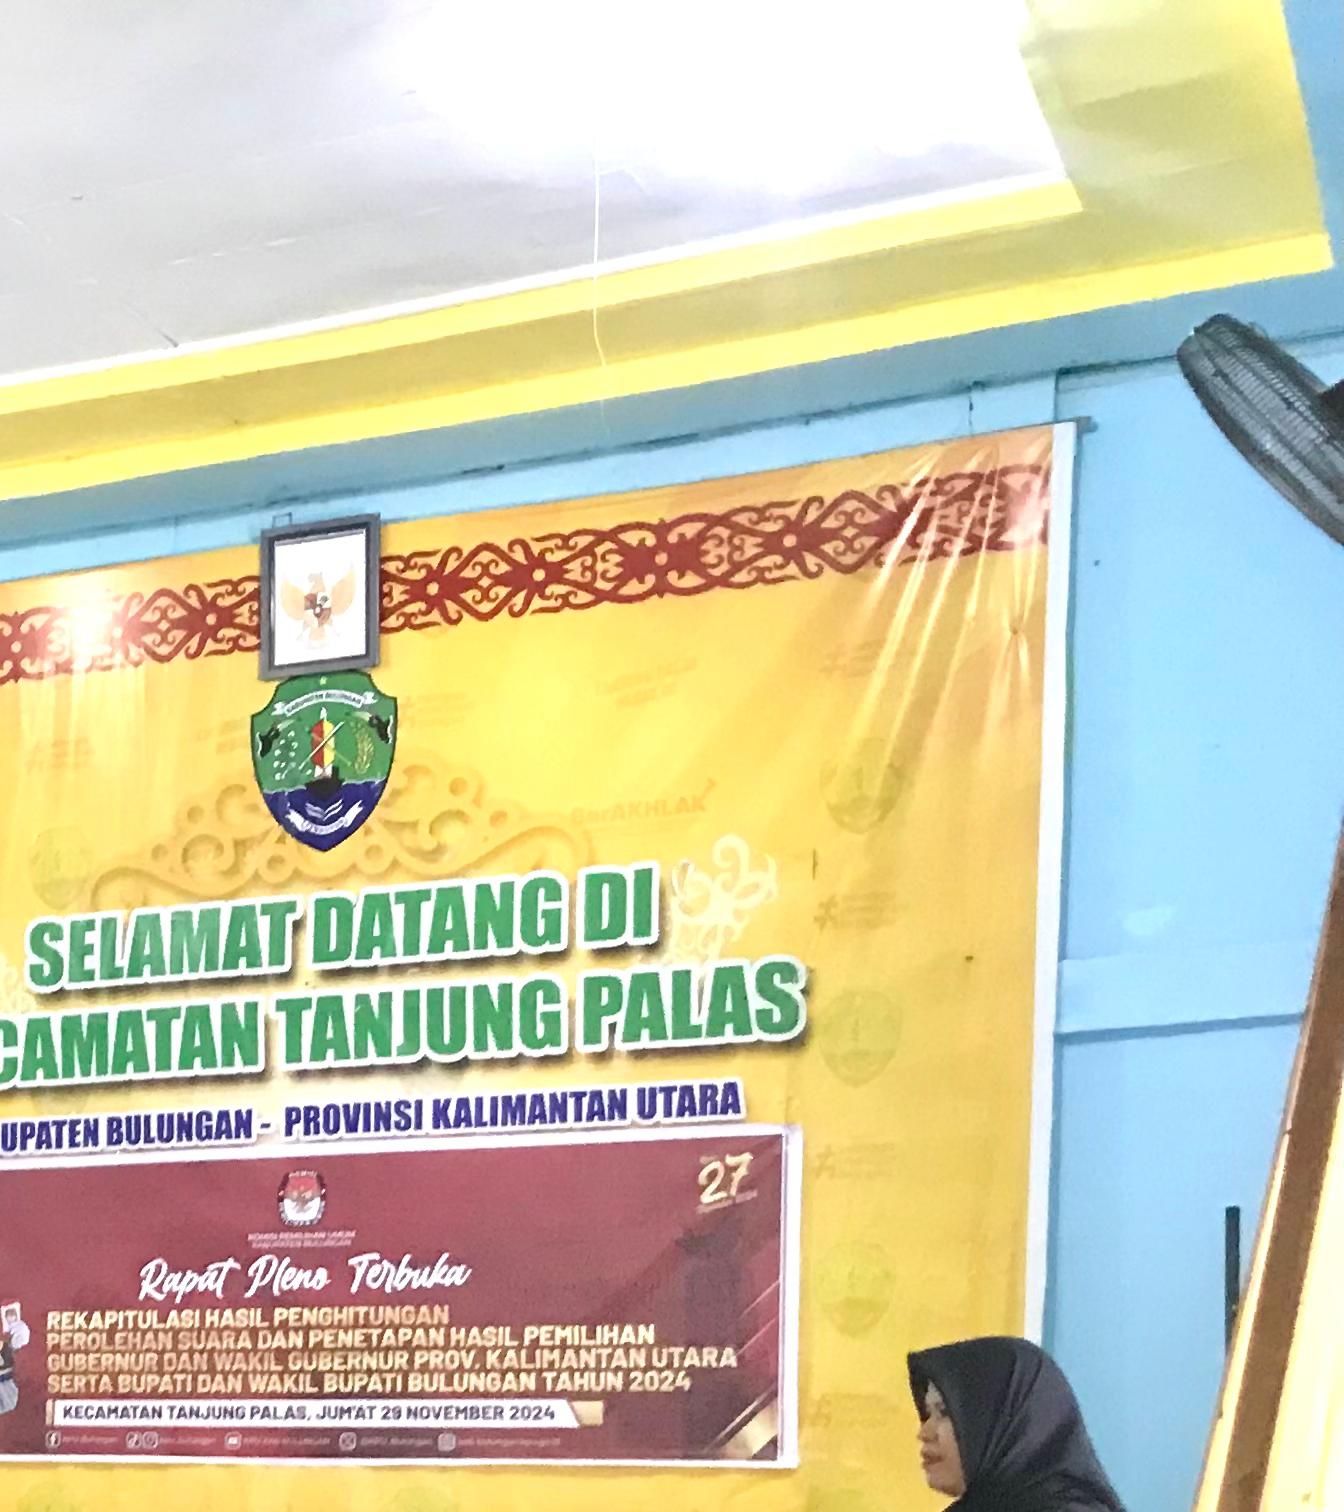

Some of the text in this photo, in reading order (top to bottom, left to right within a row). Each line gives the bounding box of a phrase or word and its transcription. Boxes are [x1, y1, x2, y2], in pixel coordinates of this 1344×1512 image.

[28, 867, 654, 987] SELAMAT DATANG DI
[275, 978, 561, 1065] TANJUNG
[583, 961, 800, 1046] PALAS
[106, 1108, 254, 1146] BULUNGAN
[284, 1099, 424, 1137] PROVINSI
[431, 1087, 628, 1130] KALIMANTAN
[636, 1081, 742, 1120] UTARA
[698, 1152, 754, 1204] 27
[138, 1252, 473, 1304] Rapat Pleno Terbuka
[46, 1305, 450, 1330] REKAPITULASI HASIL PENGHITUNGAN
[46, 1324, 656, 1351] PEROLEHAN SUARA DAN PENETAPAN HASIL PEMILIHAN
[47, 1346, 738, 1372] GUBERNUR DAN WAKIL GUBERNUR PROV. KALIMANTAN UTARA
[47, 1370, 693, 1393] SERTA BUPATI DAN WAKIL BUPATI BULUNGAN TAHUN 2024
[62, 1405, 163, 1420] KECAMATAN
[167, 1405, 246, 1420] TANJUNG
[406, 1405, 505, 1420] NOVEMBER
[509, 1405, 555, 1420] 2024
